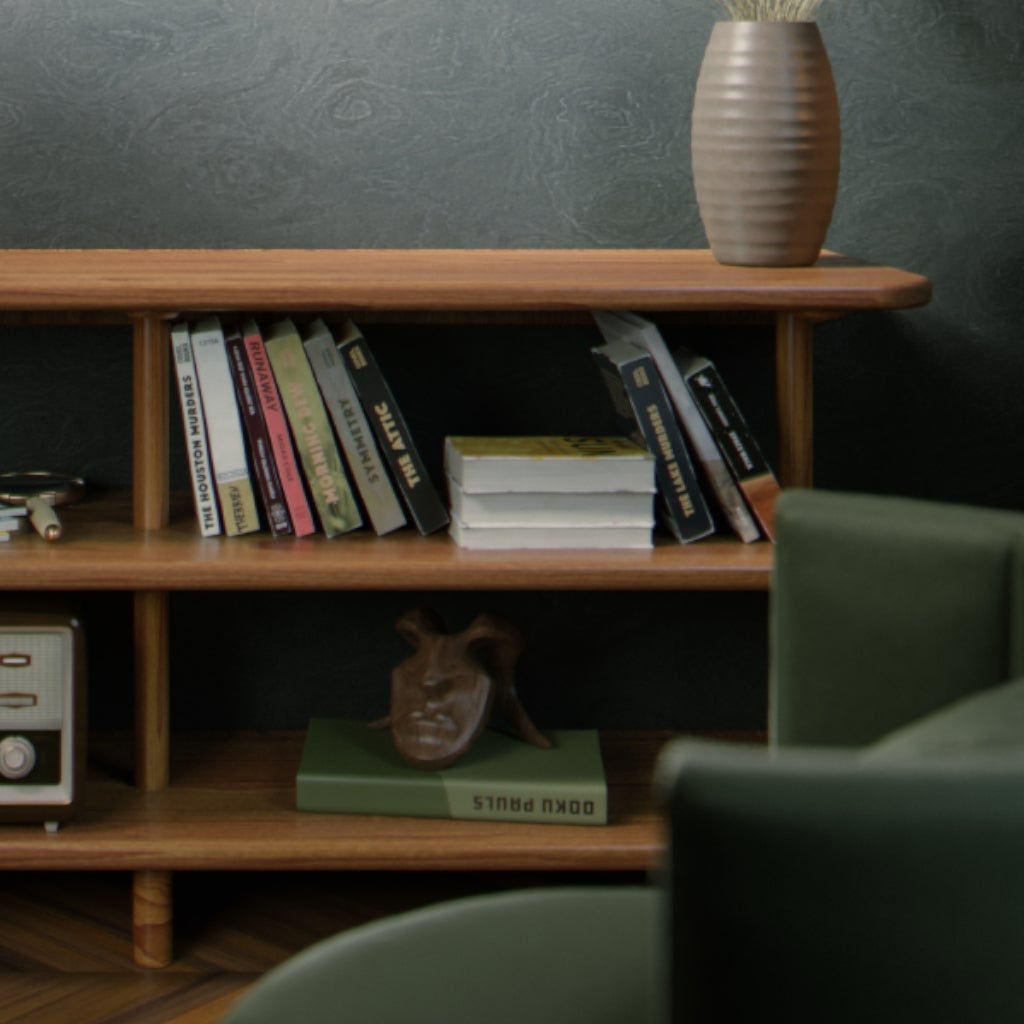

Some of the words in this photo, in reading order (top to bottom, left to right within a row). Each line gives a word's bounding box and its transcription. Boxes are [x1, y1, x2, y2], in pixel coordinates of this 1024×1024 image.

[249, 341, 279, 413] RUNAWAY
[289, 382, 311, 420] DEW
[182, 375, 200, 435] MURDERS
[374, 401, 405, 451] ATTIC
[302, 422, 339, 505] MORNING
[338, 397, 378, 486] SYMMETRY
[191, 440, 210, 502] HOUSTON
[397, 451, 421, 489] THE
[201, 506, 214, 529] THE
[678, 493, 695, 519] THE
[473, 795, 535, 813] PAULS
